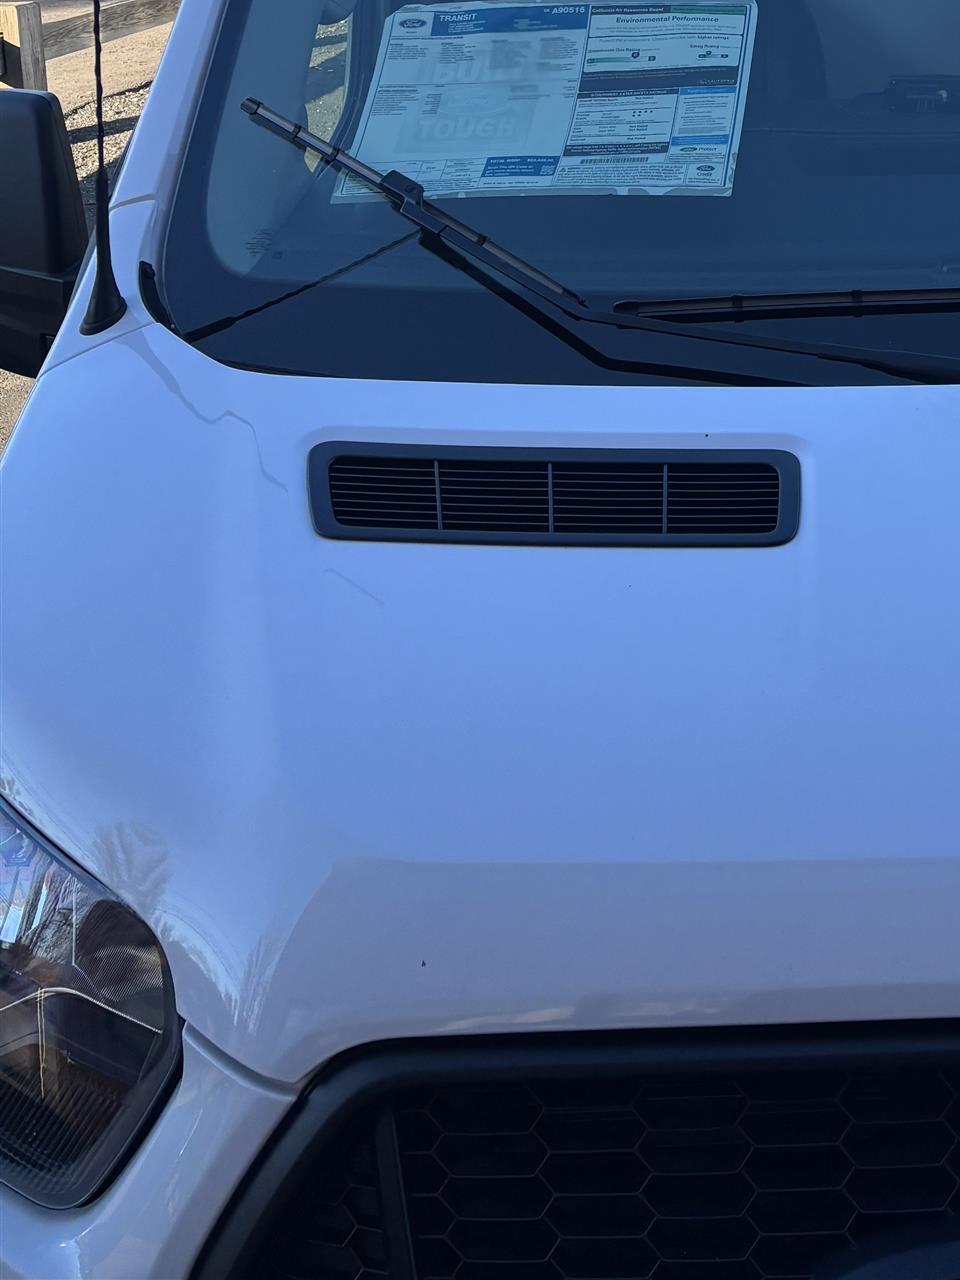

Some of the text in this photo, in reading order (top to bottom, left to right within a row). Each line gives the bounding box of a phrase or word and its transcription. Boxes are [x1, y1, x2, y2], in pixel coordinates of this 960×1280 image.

[552, 6, 585, 14] A90516
[439, 13, 478, 22] TRANSIT
[616, 15, 670, 24] Environmental
